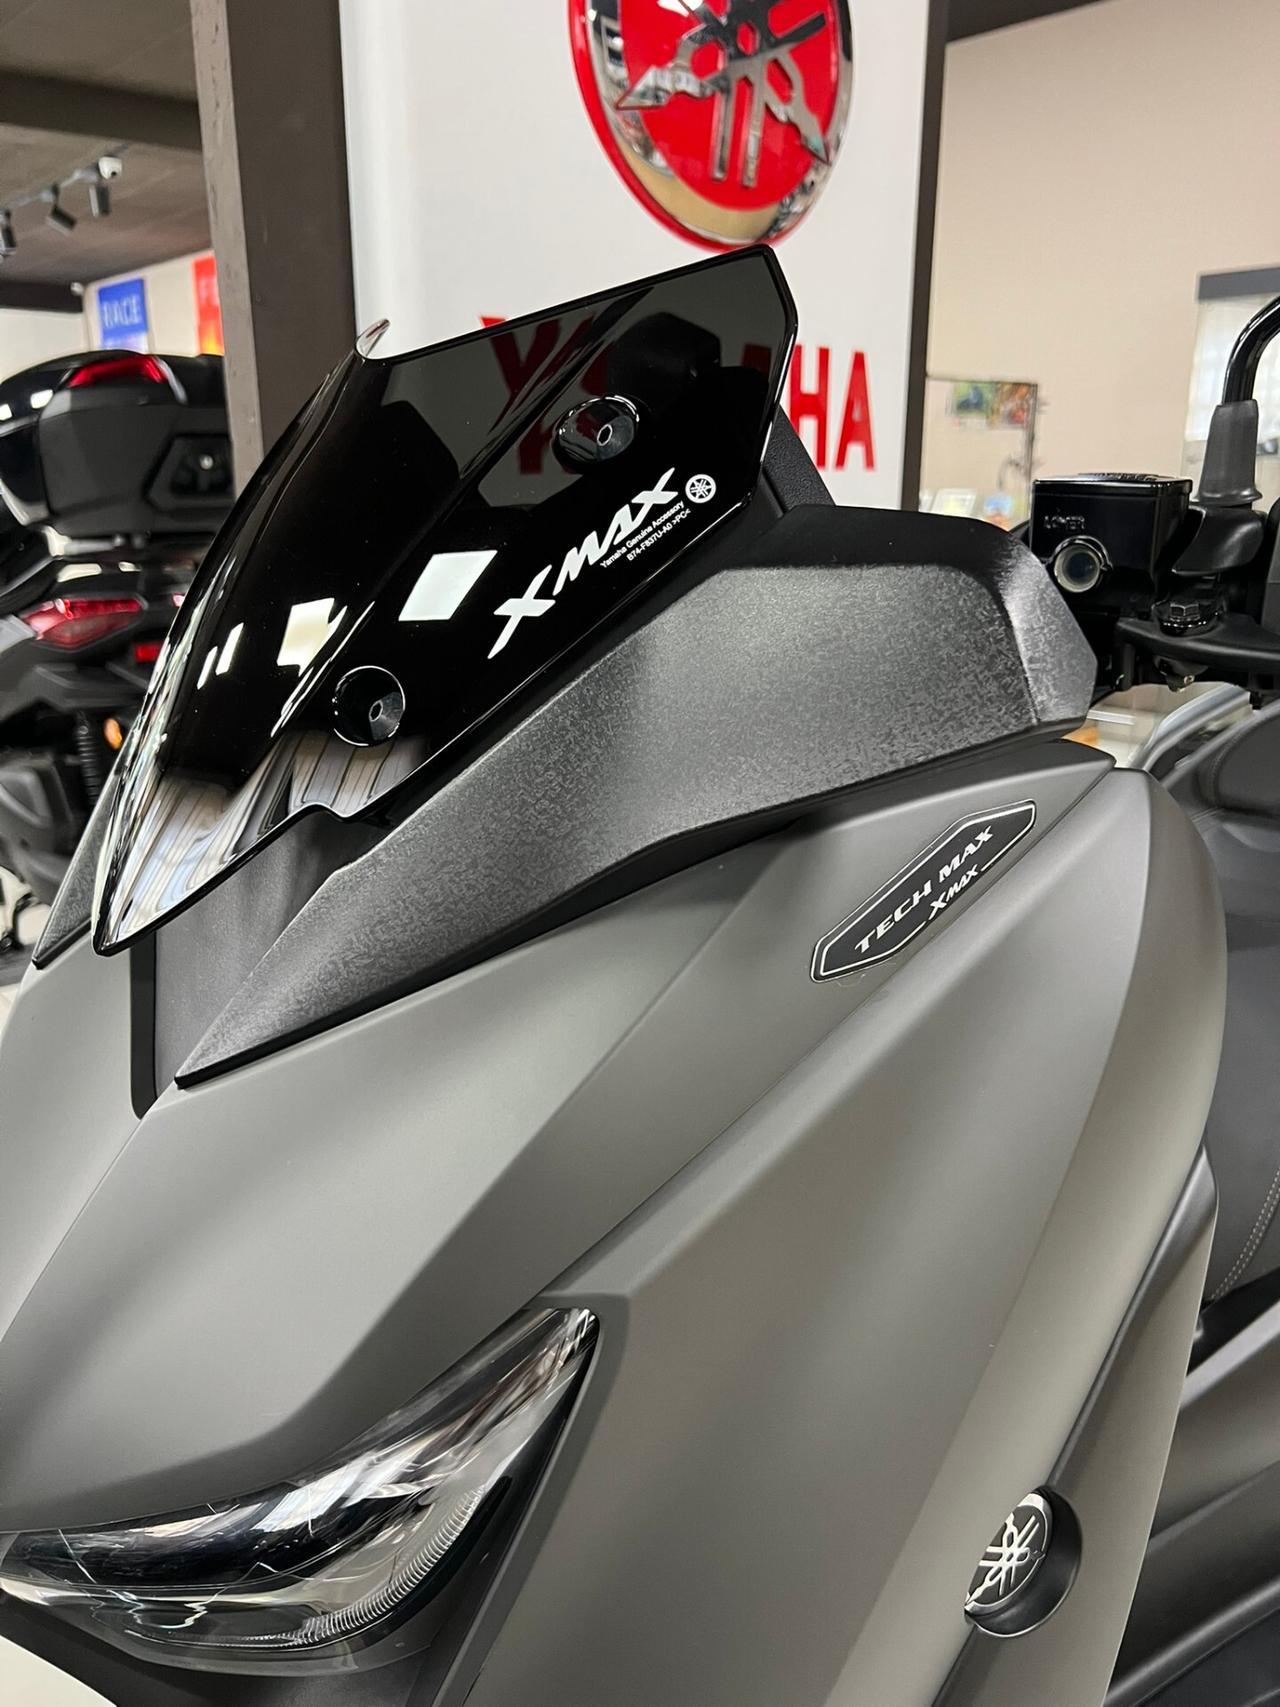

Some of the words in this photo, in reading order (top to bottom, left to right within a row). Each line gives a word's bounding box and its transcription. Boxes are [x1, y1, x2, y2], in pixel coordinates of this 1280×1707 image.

[600, 546, 628, 568] Yamaha
[625, 525, 653, 548] Genuine
[652, 500, 685, 529] Accessory
[854, 879, 932, 953] TECH
[938, 825, 994, 883] MAX
[928, 863, 979, 921] XMAX
